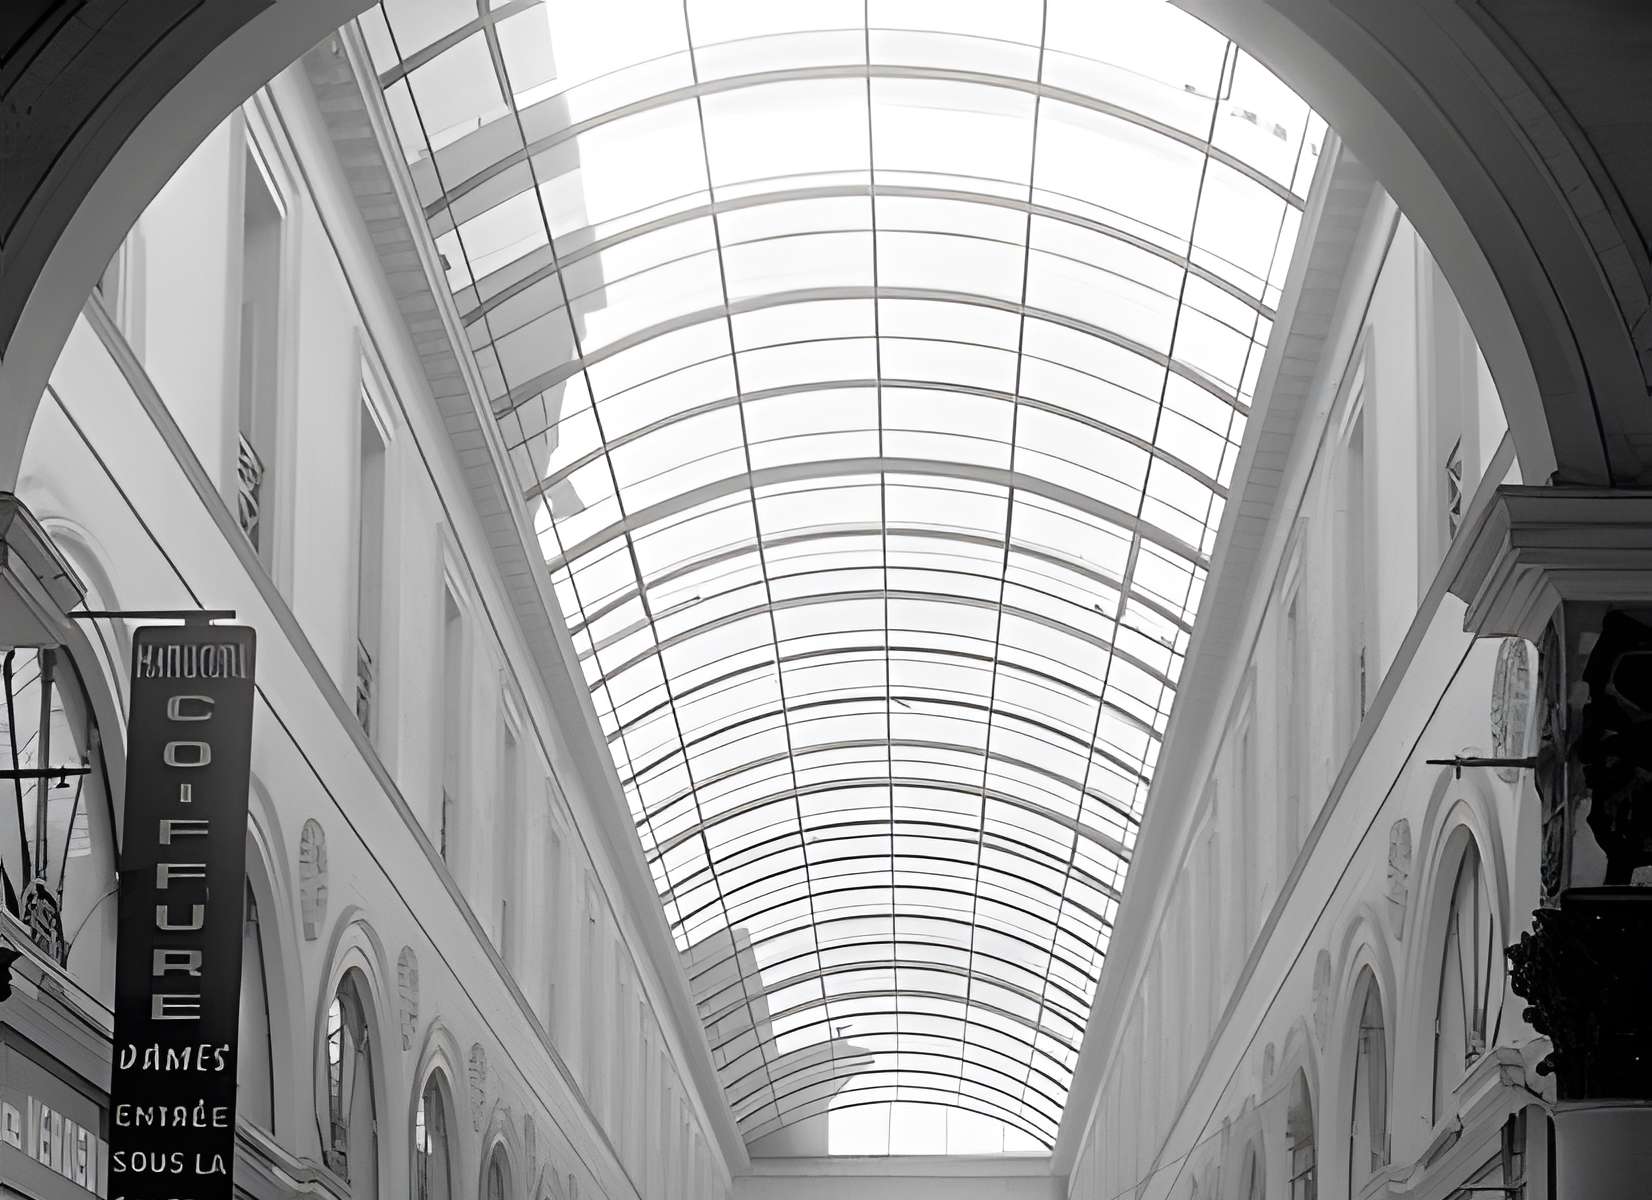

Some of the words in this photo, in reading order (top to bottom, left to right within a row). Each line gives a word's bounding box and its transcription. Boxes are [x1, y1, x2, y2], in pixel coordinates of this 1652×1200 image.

[152, 695, 215, 1020] COIFFURE
[119, 1043, 230, 1072] DAMES
[113, 1151, 184, 1174] SOUS
[195, 1153, 226, 1175] LA
